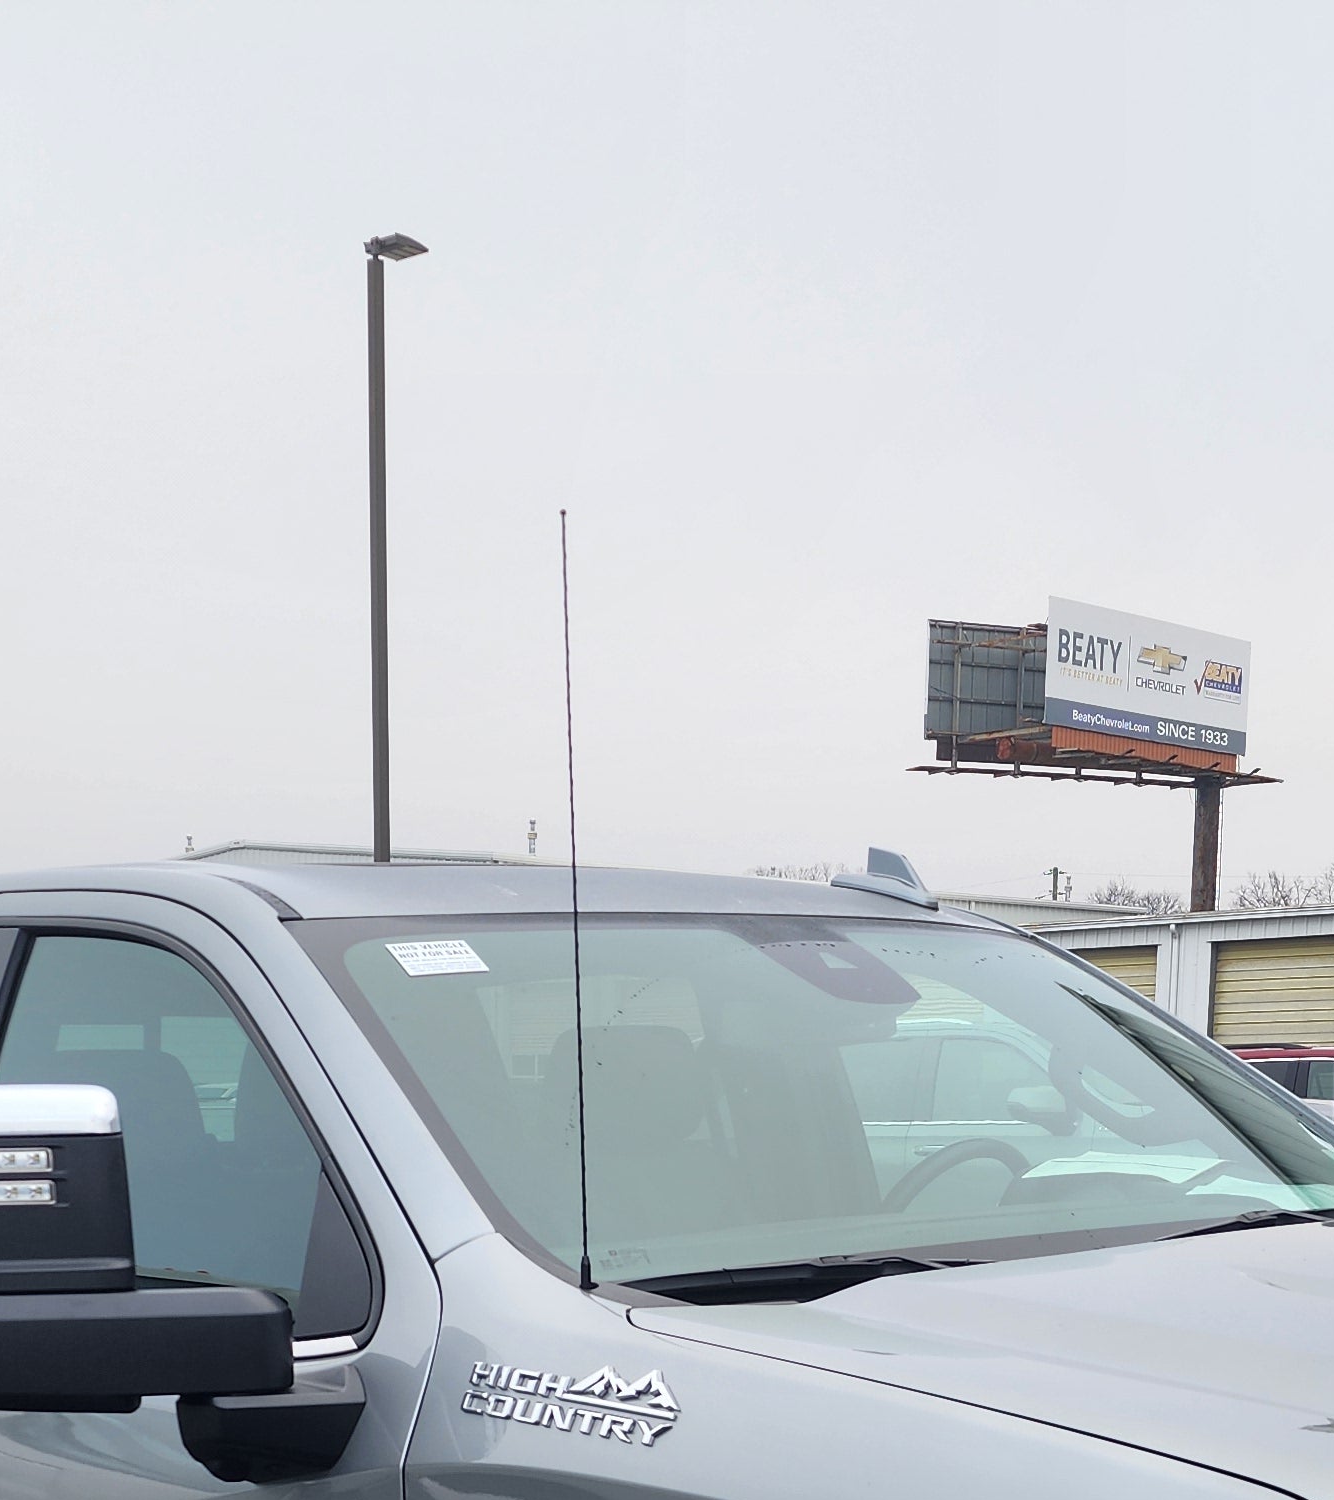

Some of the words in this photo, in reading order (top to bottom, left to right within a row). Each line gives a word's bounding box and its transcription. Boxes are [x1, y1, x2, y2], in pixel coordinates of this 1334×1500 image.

[1058, 628, 1123, 674] BEATY
[1073, 669, 1095, 681] BETTER
[1097, 674, 1104, 683] AT
[1105, 675, 1123, 687] BEATY
[1205, 661, 1242, 685] BEATY
[1135, 676, 1186, 696] CHEVROLET
[1072, 709, 1150, 734] BeatyChevrolet.com
[1156, 721, 1196, 741] SINCE
[1200, 729, 1229, 746] 1933
[398, 951, 419, 959] NOT
[446, 948, 471, 956] SALE
[419, 942, 466, 950] VEHICLE
[469, 1361, 574, 1400] HIGH
[461, 1389, 673, 1448] COUNTRY
